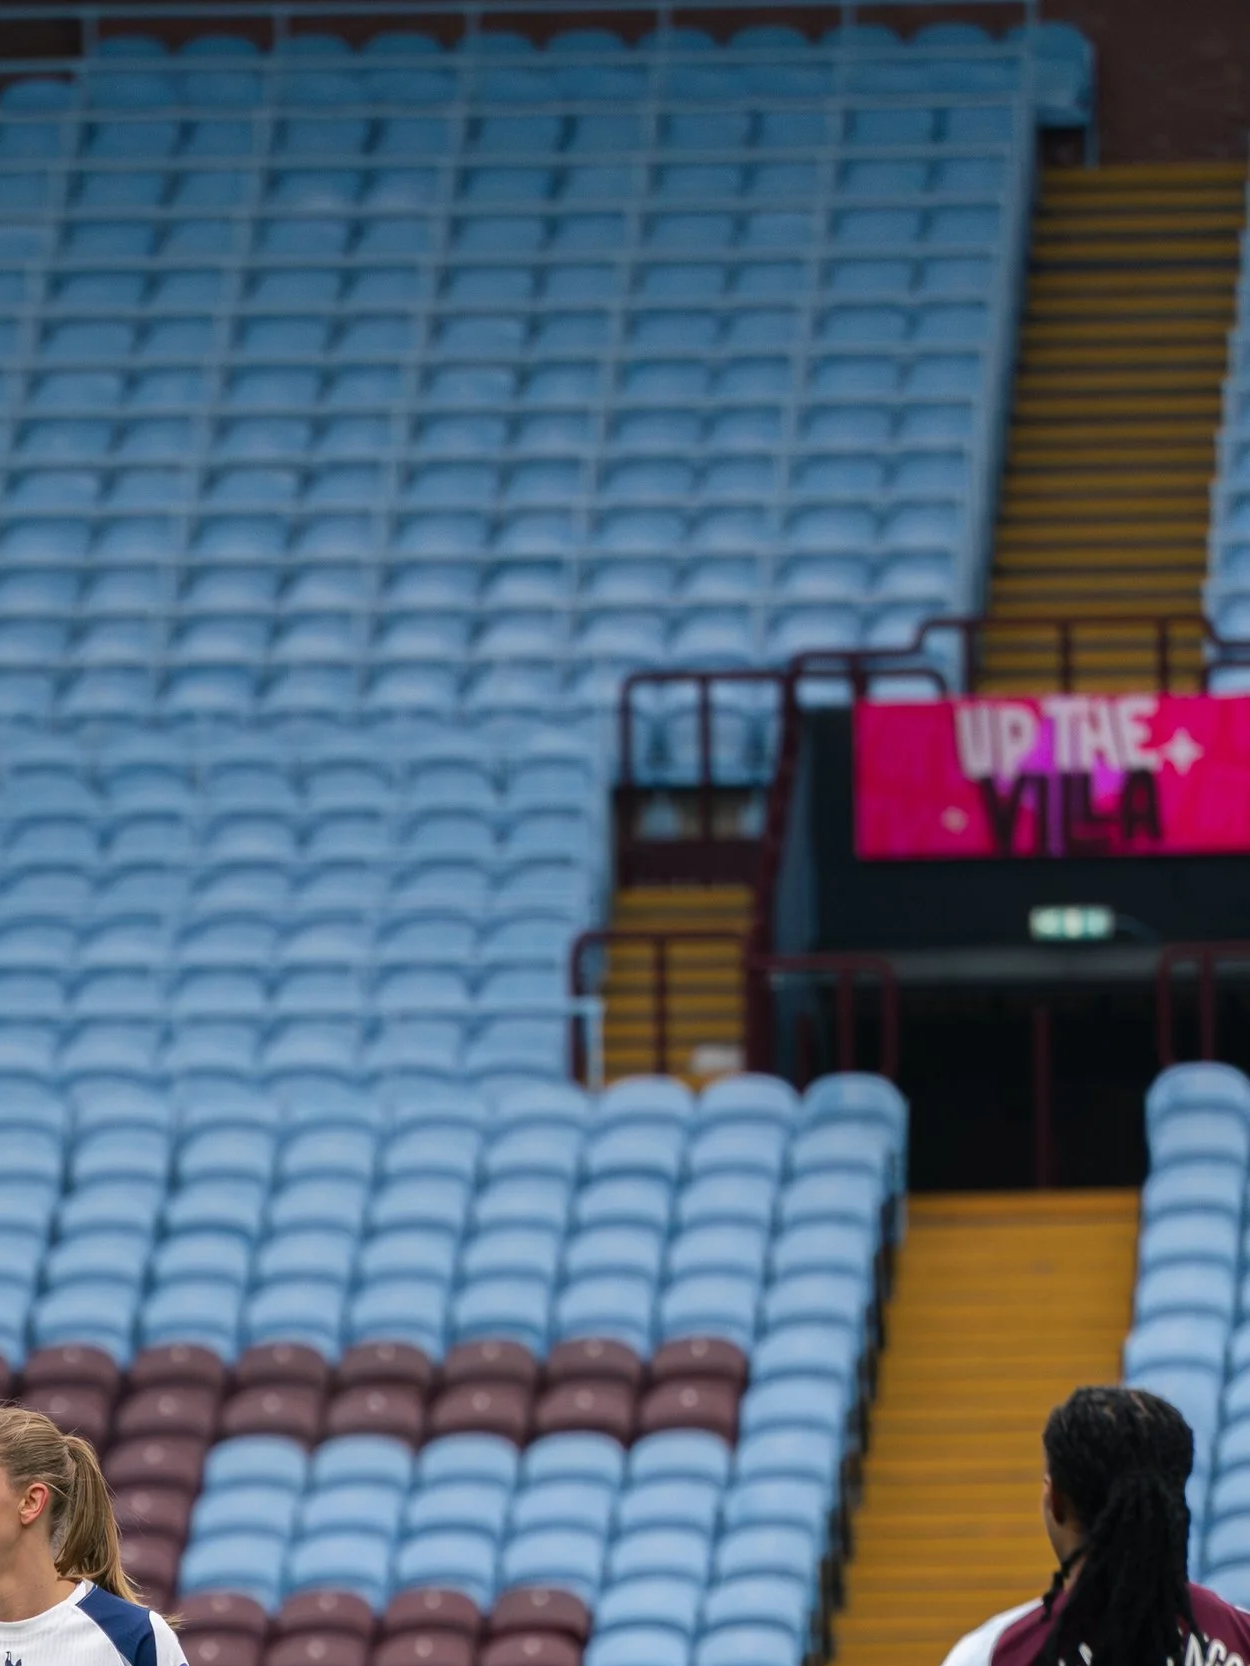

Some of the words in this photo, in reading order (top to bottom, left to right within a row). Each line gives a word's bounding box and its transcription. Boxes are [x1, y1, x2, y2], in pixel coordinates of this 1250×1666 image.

[954, 701, 1039, 781] UP
[1042, 696, 1163, 773] THE
[980, 766, 1161, 856] VILLA
